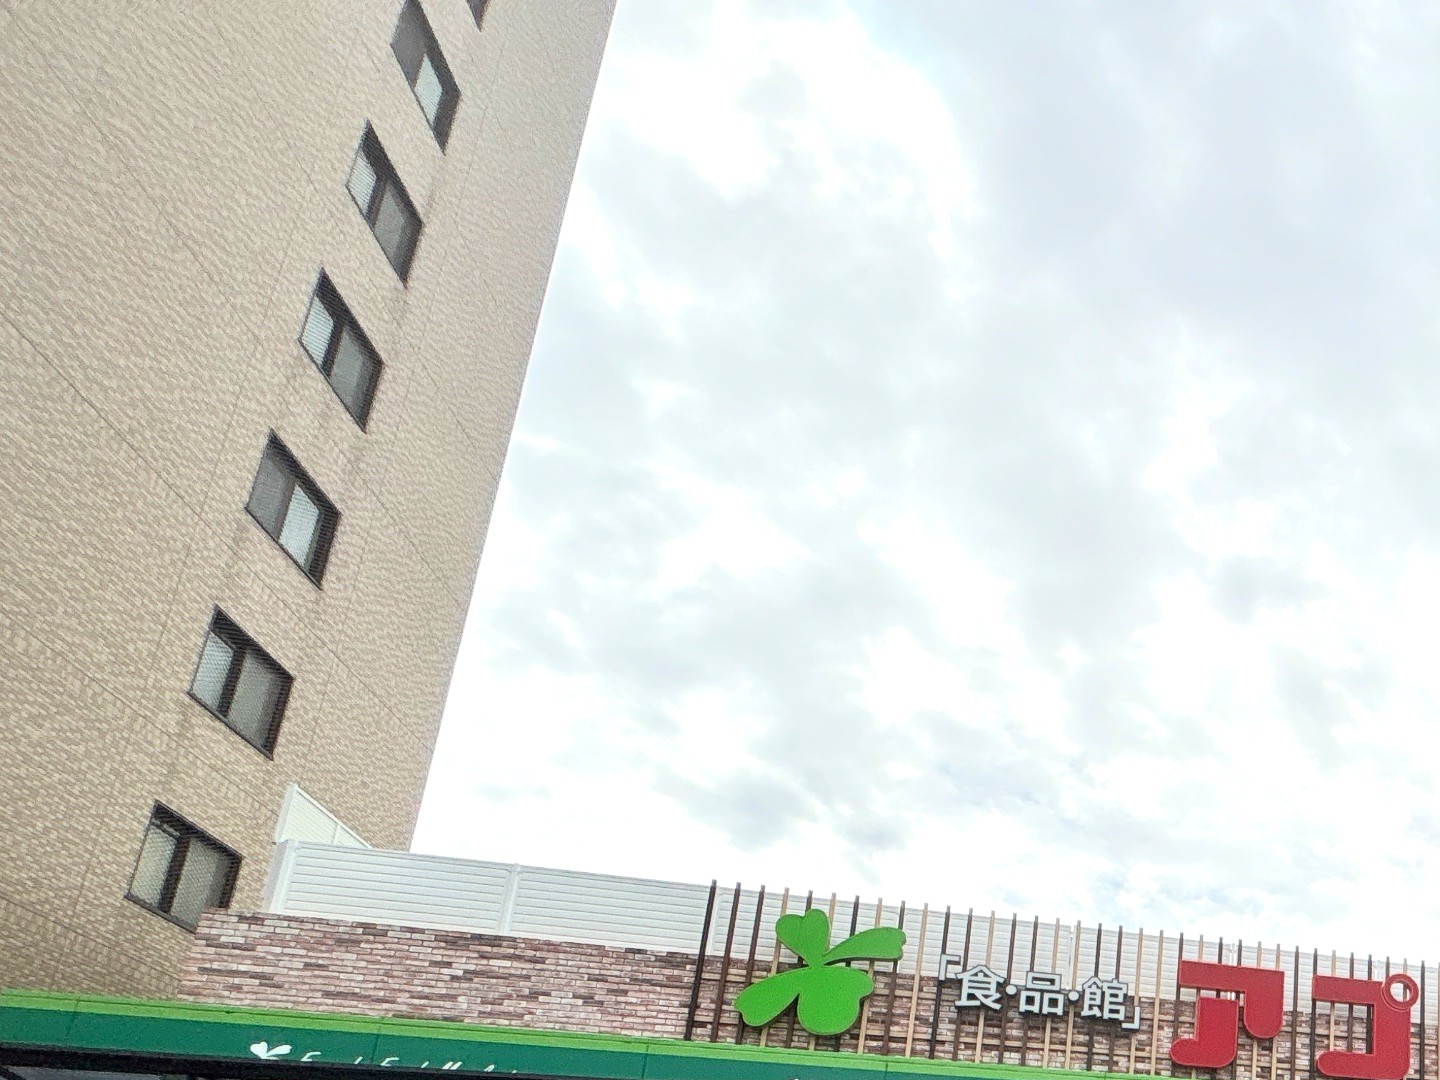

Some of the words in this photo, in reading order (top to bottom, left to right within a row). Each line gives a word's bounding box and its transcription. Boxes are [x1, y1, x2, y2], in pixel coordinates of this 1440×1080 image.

[938, 953, 1141, 1031] 「食・品・館」
